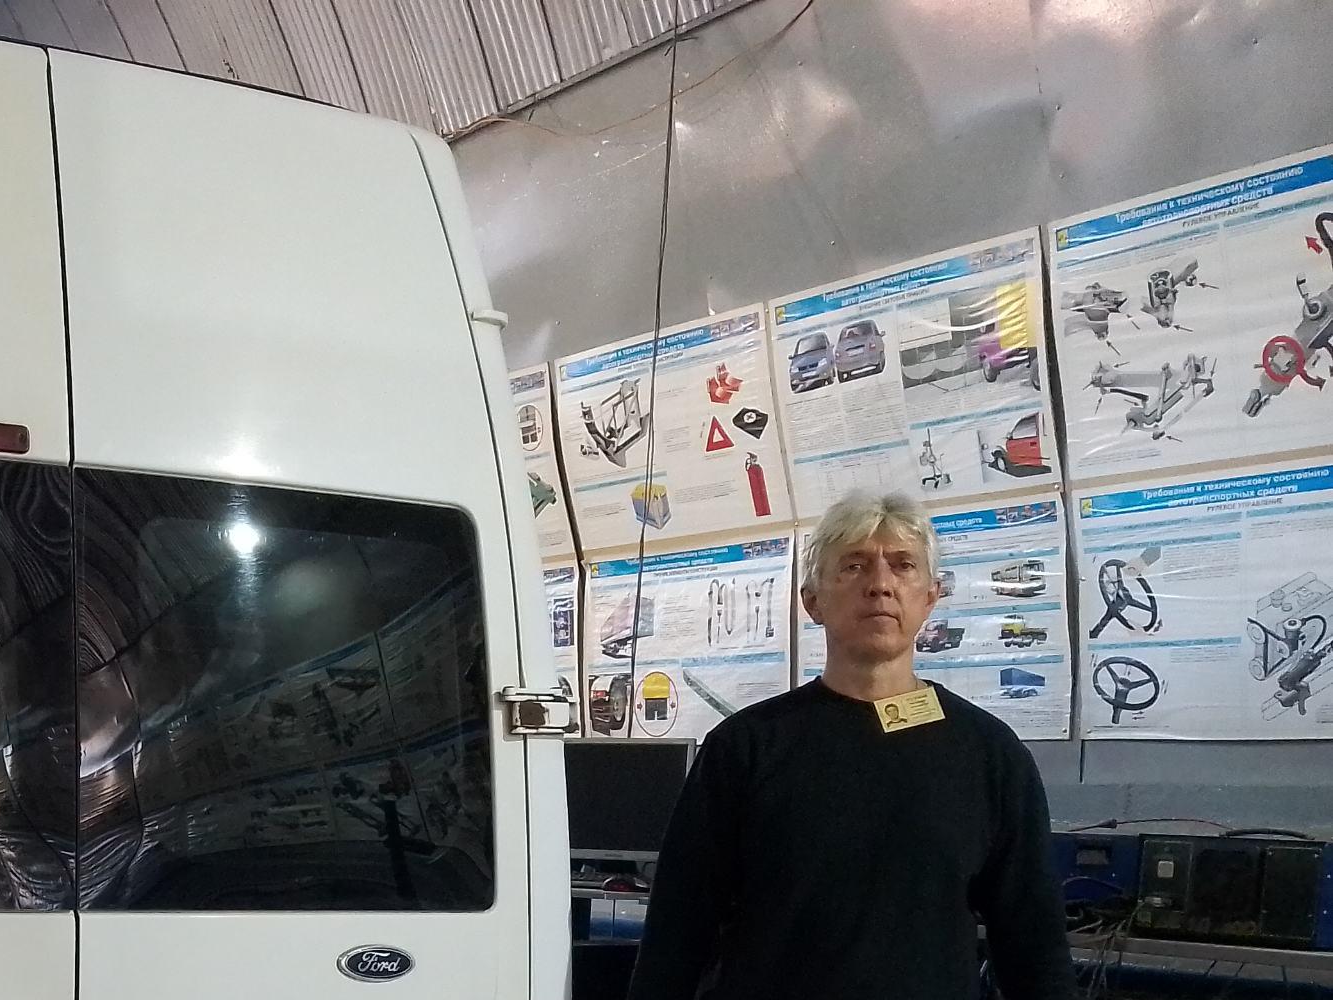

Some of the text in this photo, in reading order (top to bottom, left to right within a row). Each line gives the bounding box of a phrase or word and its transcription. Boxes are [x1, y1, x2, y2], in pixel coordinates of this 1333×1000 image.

[1142, 486, 1196, 499] Требования
[1203, 476, 1272, 492] техническому
[1273, 469, 1330, 483] состоянию
[1256, 484, 1299, 497] средств
[357, 951, 402, 972] Ford
